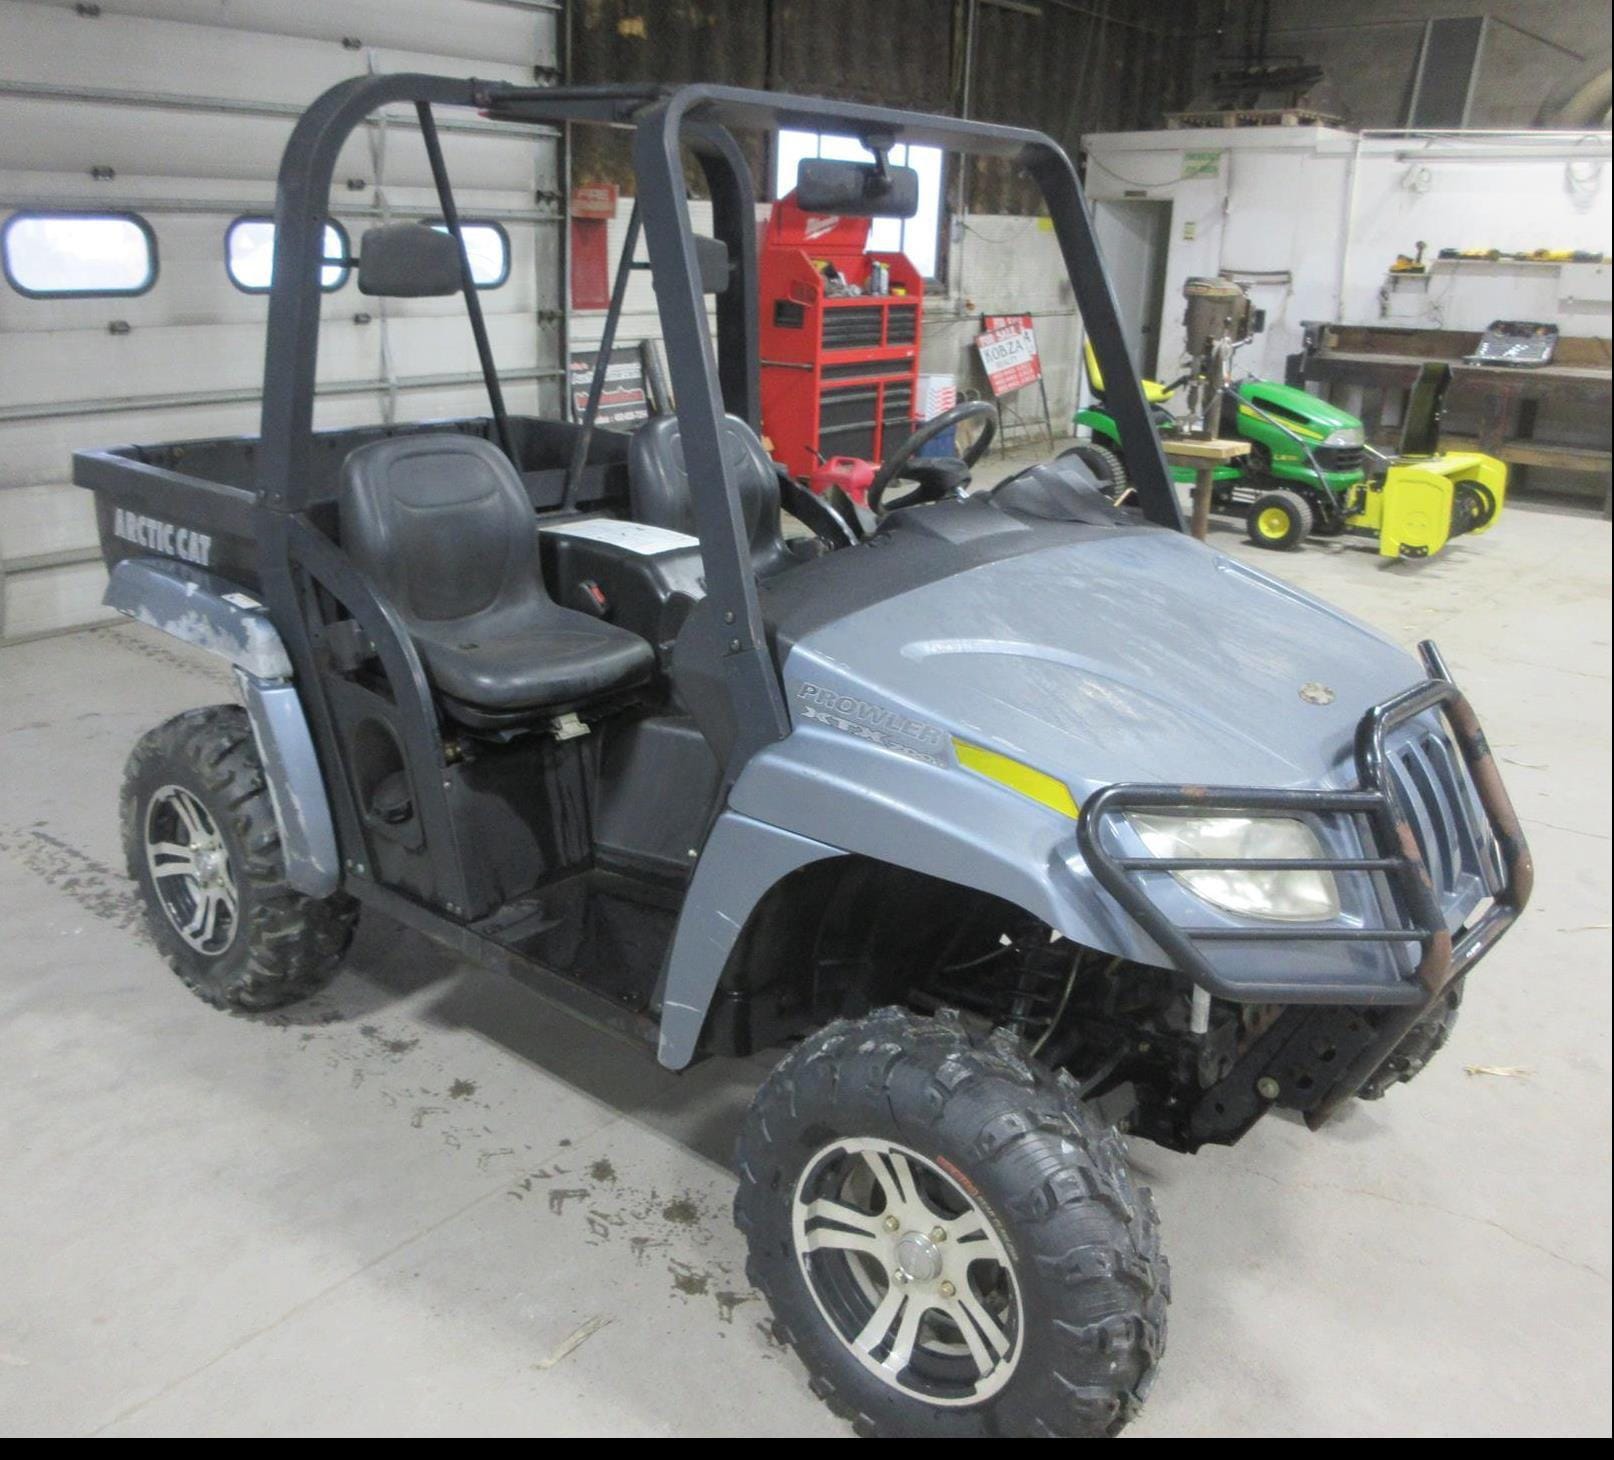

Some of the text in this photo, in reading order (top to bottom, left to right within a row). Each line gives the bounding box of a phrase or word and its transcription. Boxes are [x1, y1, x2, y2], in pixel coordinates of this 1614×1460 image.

[983, 339, 1025, 362] KOBZA
[114, 508, 212, 567] ARCTIC CAT
[797, 682, 945, 746] PROWLER
[801, 706, 889, 744] XTX
